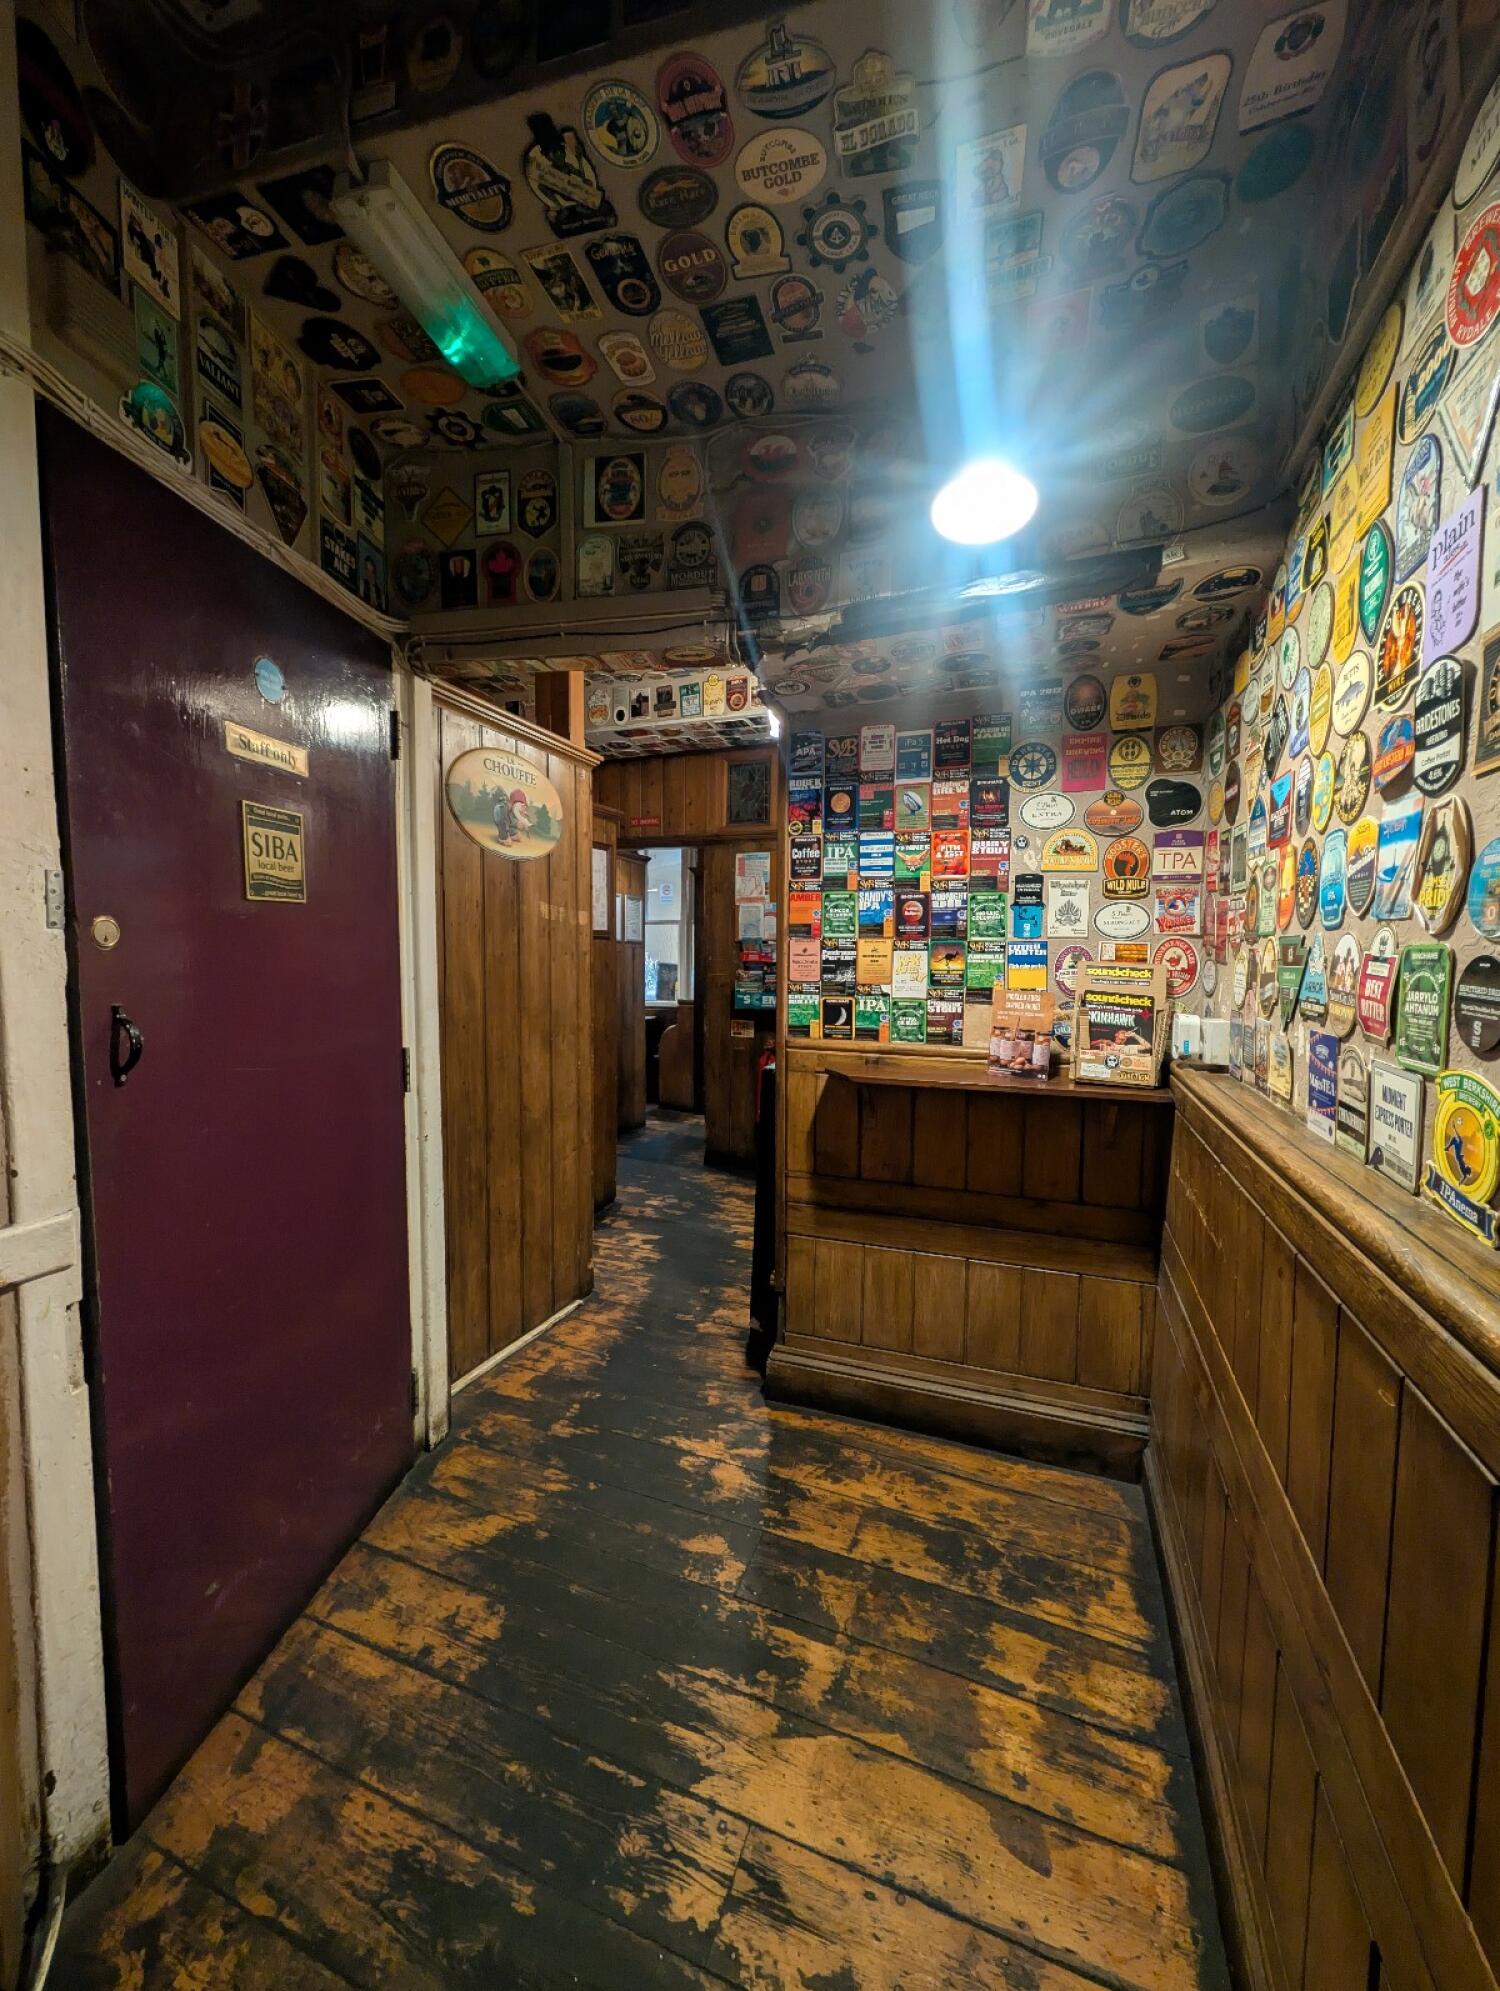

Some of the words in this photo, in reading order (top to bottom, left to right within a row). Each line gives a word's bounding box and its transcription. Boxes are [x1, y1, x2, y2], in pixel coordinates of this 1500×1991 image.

[741, 153, 820, 182] BUTCOMBE
[763, 170, 803, 190] GOLD
[664, 249, 717, 273] GOLD
[199, 358, 240, 398] VALIANT
[1431, 508, 1476, 570] plain
[1416, 698, 1461, 734] BRIDESTONES
[239, 734, 270, 758] Staff
[273, 751, 297, 770] only
[483, 758, 537, 786] CHOUFFE
[1170, 809, 1193, 817] ATOM
[252, 832, 298, 862] SIBA
[792, 848, 821, 860] Coffee
[828, 847, 855, 859] IPA
[258, 859, 276, 871] local
[278, 861, 295, 873] beer
[1158, 852, 1198, 871] TPA
[1106, 881, 1126, 891] WILD
[791, 893, 821, 902] AMBER
[859, 890, 894, 902] SANDY'S
[1365, 979, 1384, 1000] BEST
[1406, 990, 1439, 1004] JARRYLO
[862, 999, 887, 1012] IPA
[1404, 1002, 1440, 1016] AHTANUM
[1443, 1078, 1461, 1089] WEST
[1395, 1114, 1414, 1140] PORTER
[1440, 1179, 1479, 1223] IPAnema
